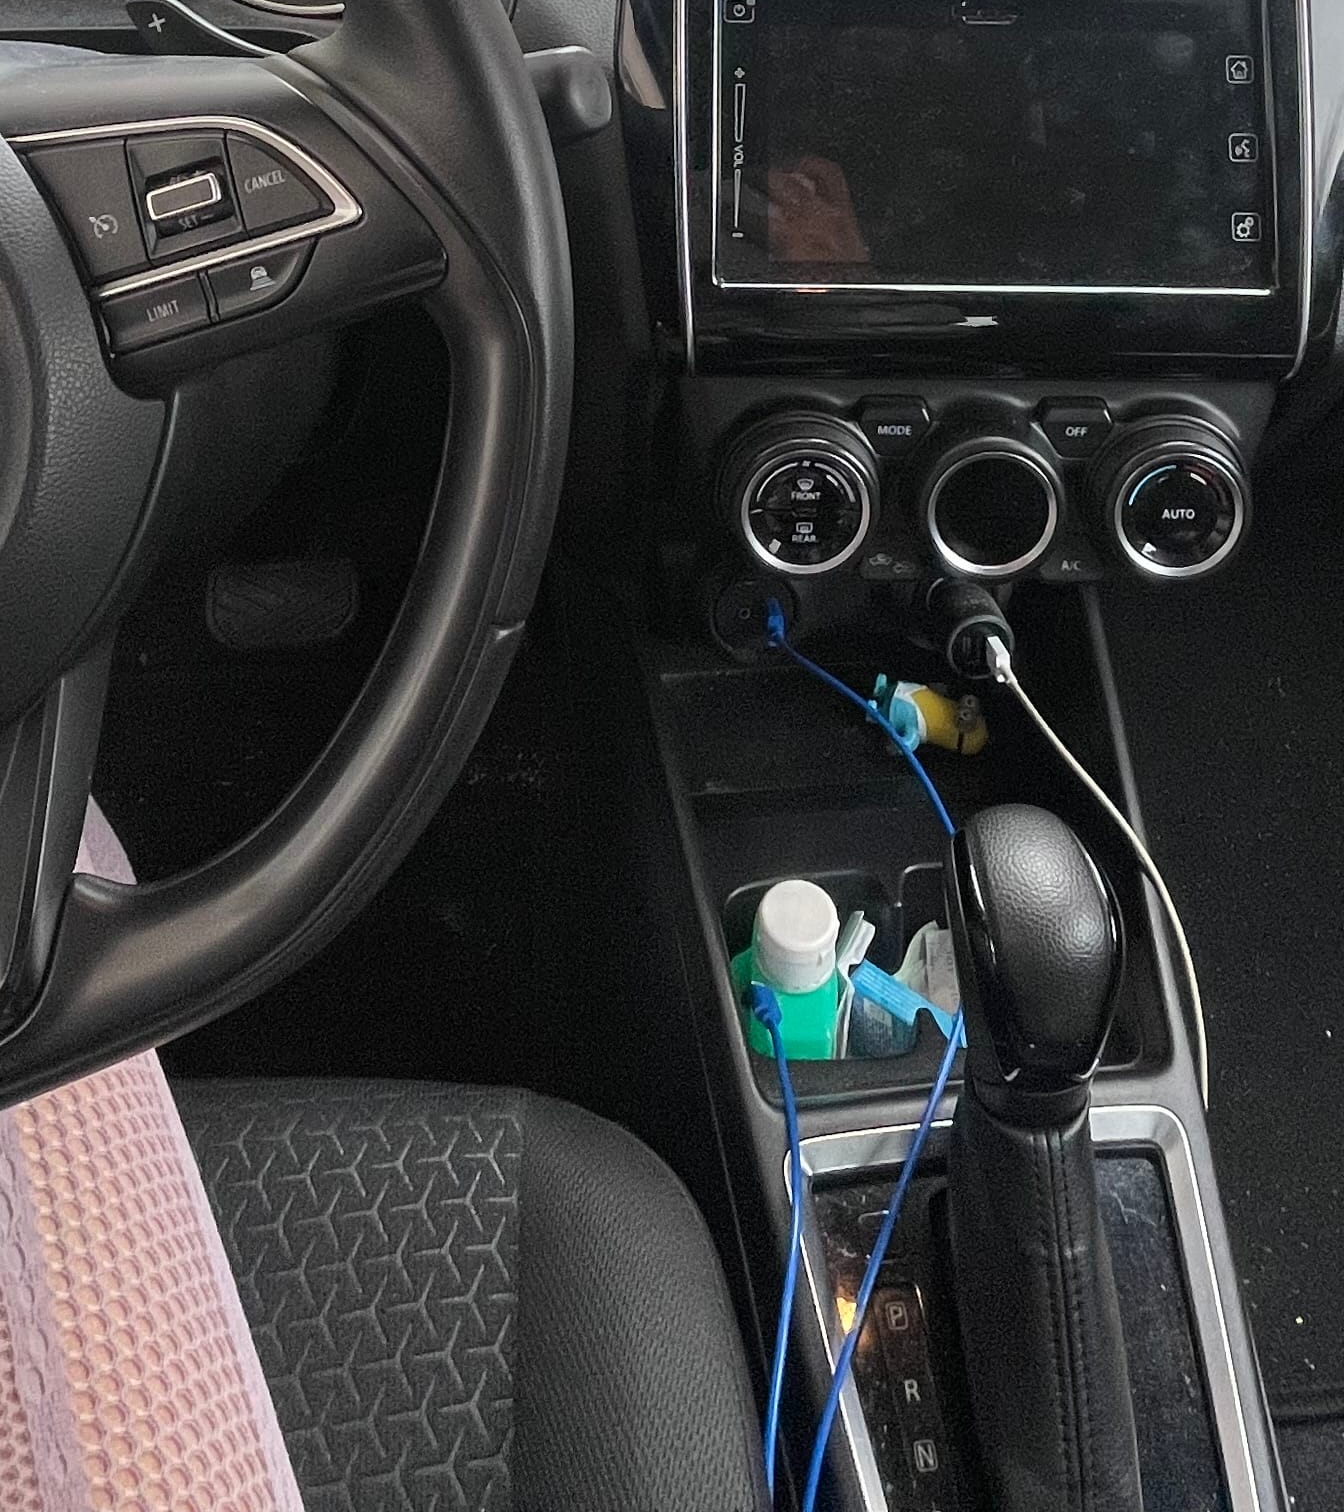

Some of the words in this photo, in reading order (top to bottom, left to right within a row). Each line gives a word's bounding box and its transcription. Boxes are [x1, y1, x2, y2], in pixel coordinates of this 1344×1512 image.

[733, 143, 745, 169] VOL
[244, 169, 286, 194] CANCEL
[178, 214, 200, 230] SET
[145, 299, 180, 322] LIMIT
[877, 425, 913, 436] MODE
[1065, 426, 1088, 437] OFF
[791, 491, 821, 501] FRONT
[1162, 508, 1196, 519] AUTO
[791, 534, 817, 543] REAR
[1060, 560, 1082, 571] A/C
[888, 1306, 903, 1328] P
[904, 1379, 921, 1402] R
[917, 1443, 935, 1469] N
